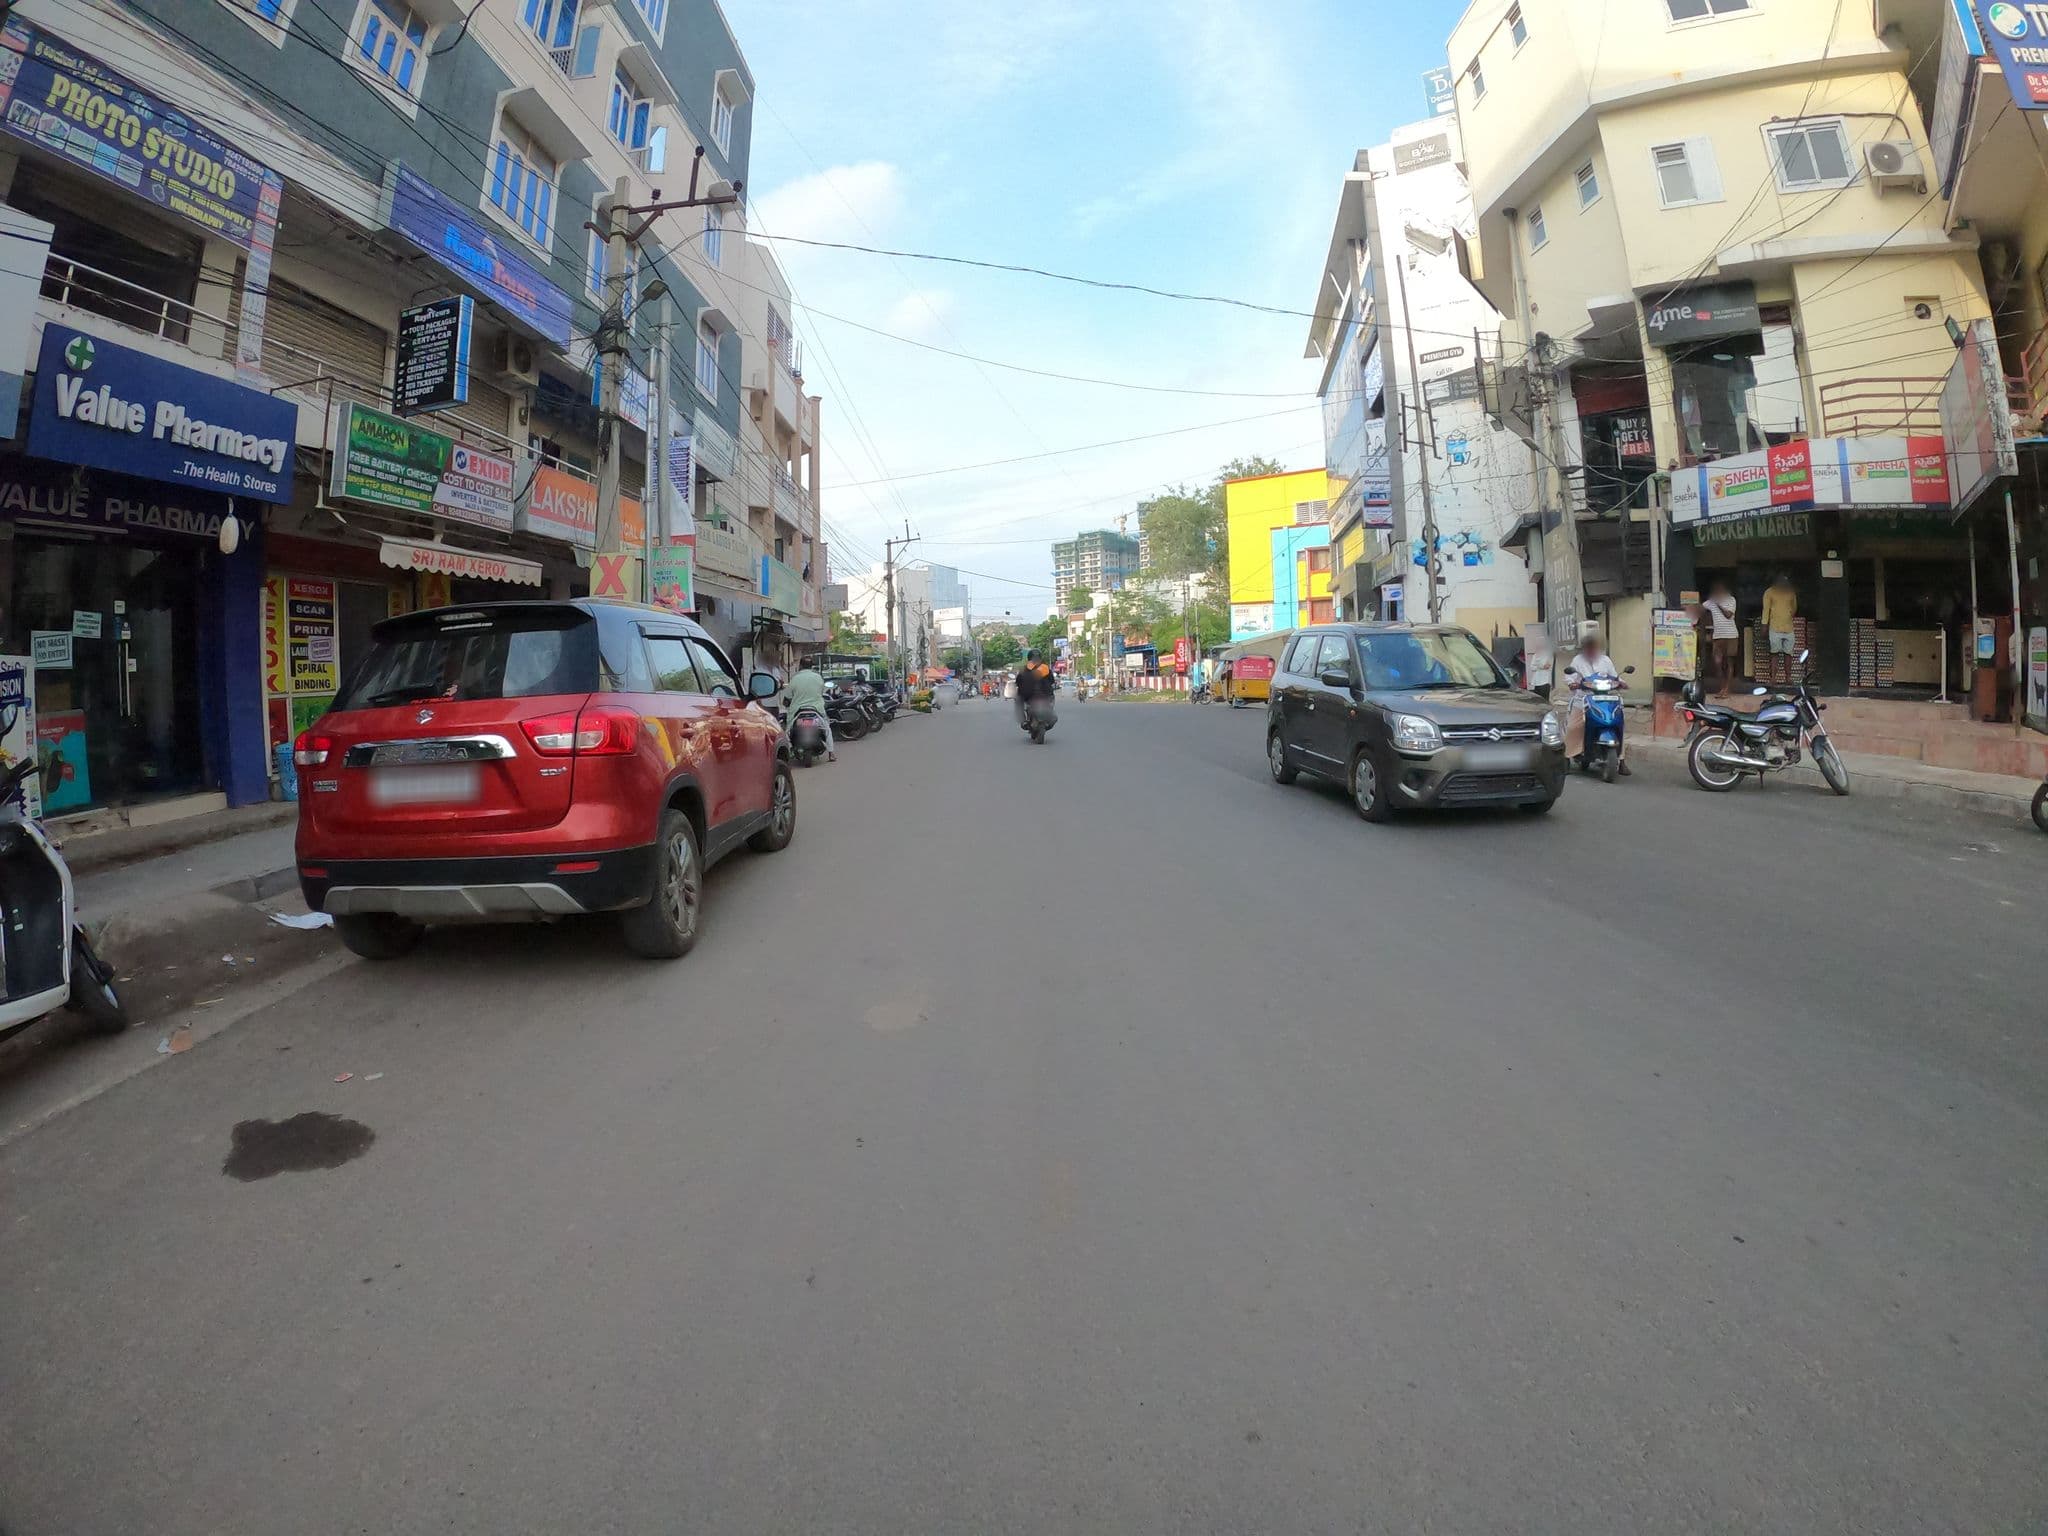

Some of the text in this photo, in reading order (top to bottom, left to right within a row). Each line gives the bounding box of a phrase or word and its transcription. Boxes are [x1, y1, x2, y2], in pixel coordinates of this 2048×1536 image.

[45, 73, 141, 148] PHOTO
[142, 127, 236, 200] STUDIO
[1423, 346, 1462, 362] PREMIUM GYM
[55, 373, 288, 474] Value Pharmacy
[358, 418, 405, 447] AMARON
[1621, 429, 1649, 442] GET 2
[349, 451, 370, 466] FREE
[371, 456, 406, 474] BATTERY
[469, 451, 511, 483] EXIDE
[1814, 469, 1839, 477] SNEHA
[204, 466, 241, 486] Health
[243, 474, 277, 494] Stores
[443, 472, 463, 488] COST
[464, 476, 475, 490] TO
[475, 479, 494, 496] COST
[1725, 466, 1768, 486] SNEHA
[1674, 491, 1698, 504] SNEHA
[105, 497, 256, 541] PHARMAY
[1697, 513, 1811, 543] CHICKEN MARKET
[411, 549, 507, 577] SRI RAM XEROX
[593, 556, 628, 595] X
[293, 583, 329, 595] XEROX
[296, 604, 326, 615] SCAN
[294, 625, 330, 636] PRINT
[297, 663, 328, 674] SPIRAL
[294, 679, 331, 690] BINDING
